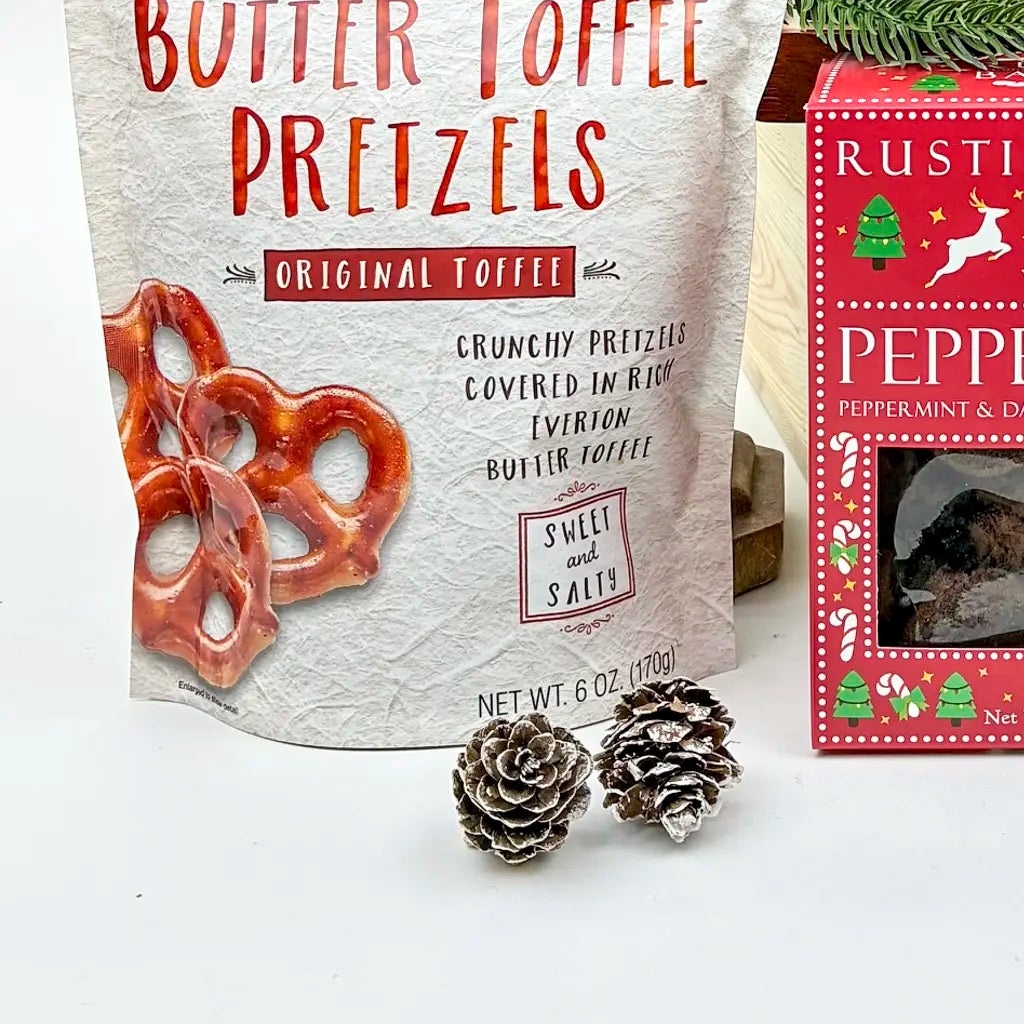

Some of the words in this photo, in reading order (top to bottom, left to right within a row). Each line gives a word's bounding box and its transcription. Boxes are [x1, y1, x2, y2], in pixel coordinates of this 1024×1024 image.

[231, 106, 606, 217] PRETZELS
[276, 256, 433, 292] ORIGINAL
[453, 255, 563, 290] TOFFEE
[456, 330, 575, 360] CRUNCHY
[589, 322, 686, 357] PRETZELS
[465, 373, 578, 401] COVERED
[591, 371, 617, 396] IN
[628, 357, 675, 392] RICH
[532, 407, 631, 440] EVERTON
[839, 400, 970, 418] PEPPERMINT
[976, 400, 993, 418] &
[487, 447, 569, 481] BUTTER
[581, 435, 653, 466] TOFFEE
[544, 505, 611, 549] SWEET
[566, 540, 599, 569] and
[547, 566, 617, 607] SALTY
[478, 689, 522, 718] NET
[530, 683, 567, 711] WT.
[575, 678, 587, 703] 6
[594, 669, 624, 698] OZ.
[629, 645, 676, 689] (170g)
[984, 709, 1018, 725] Net
